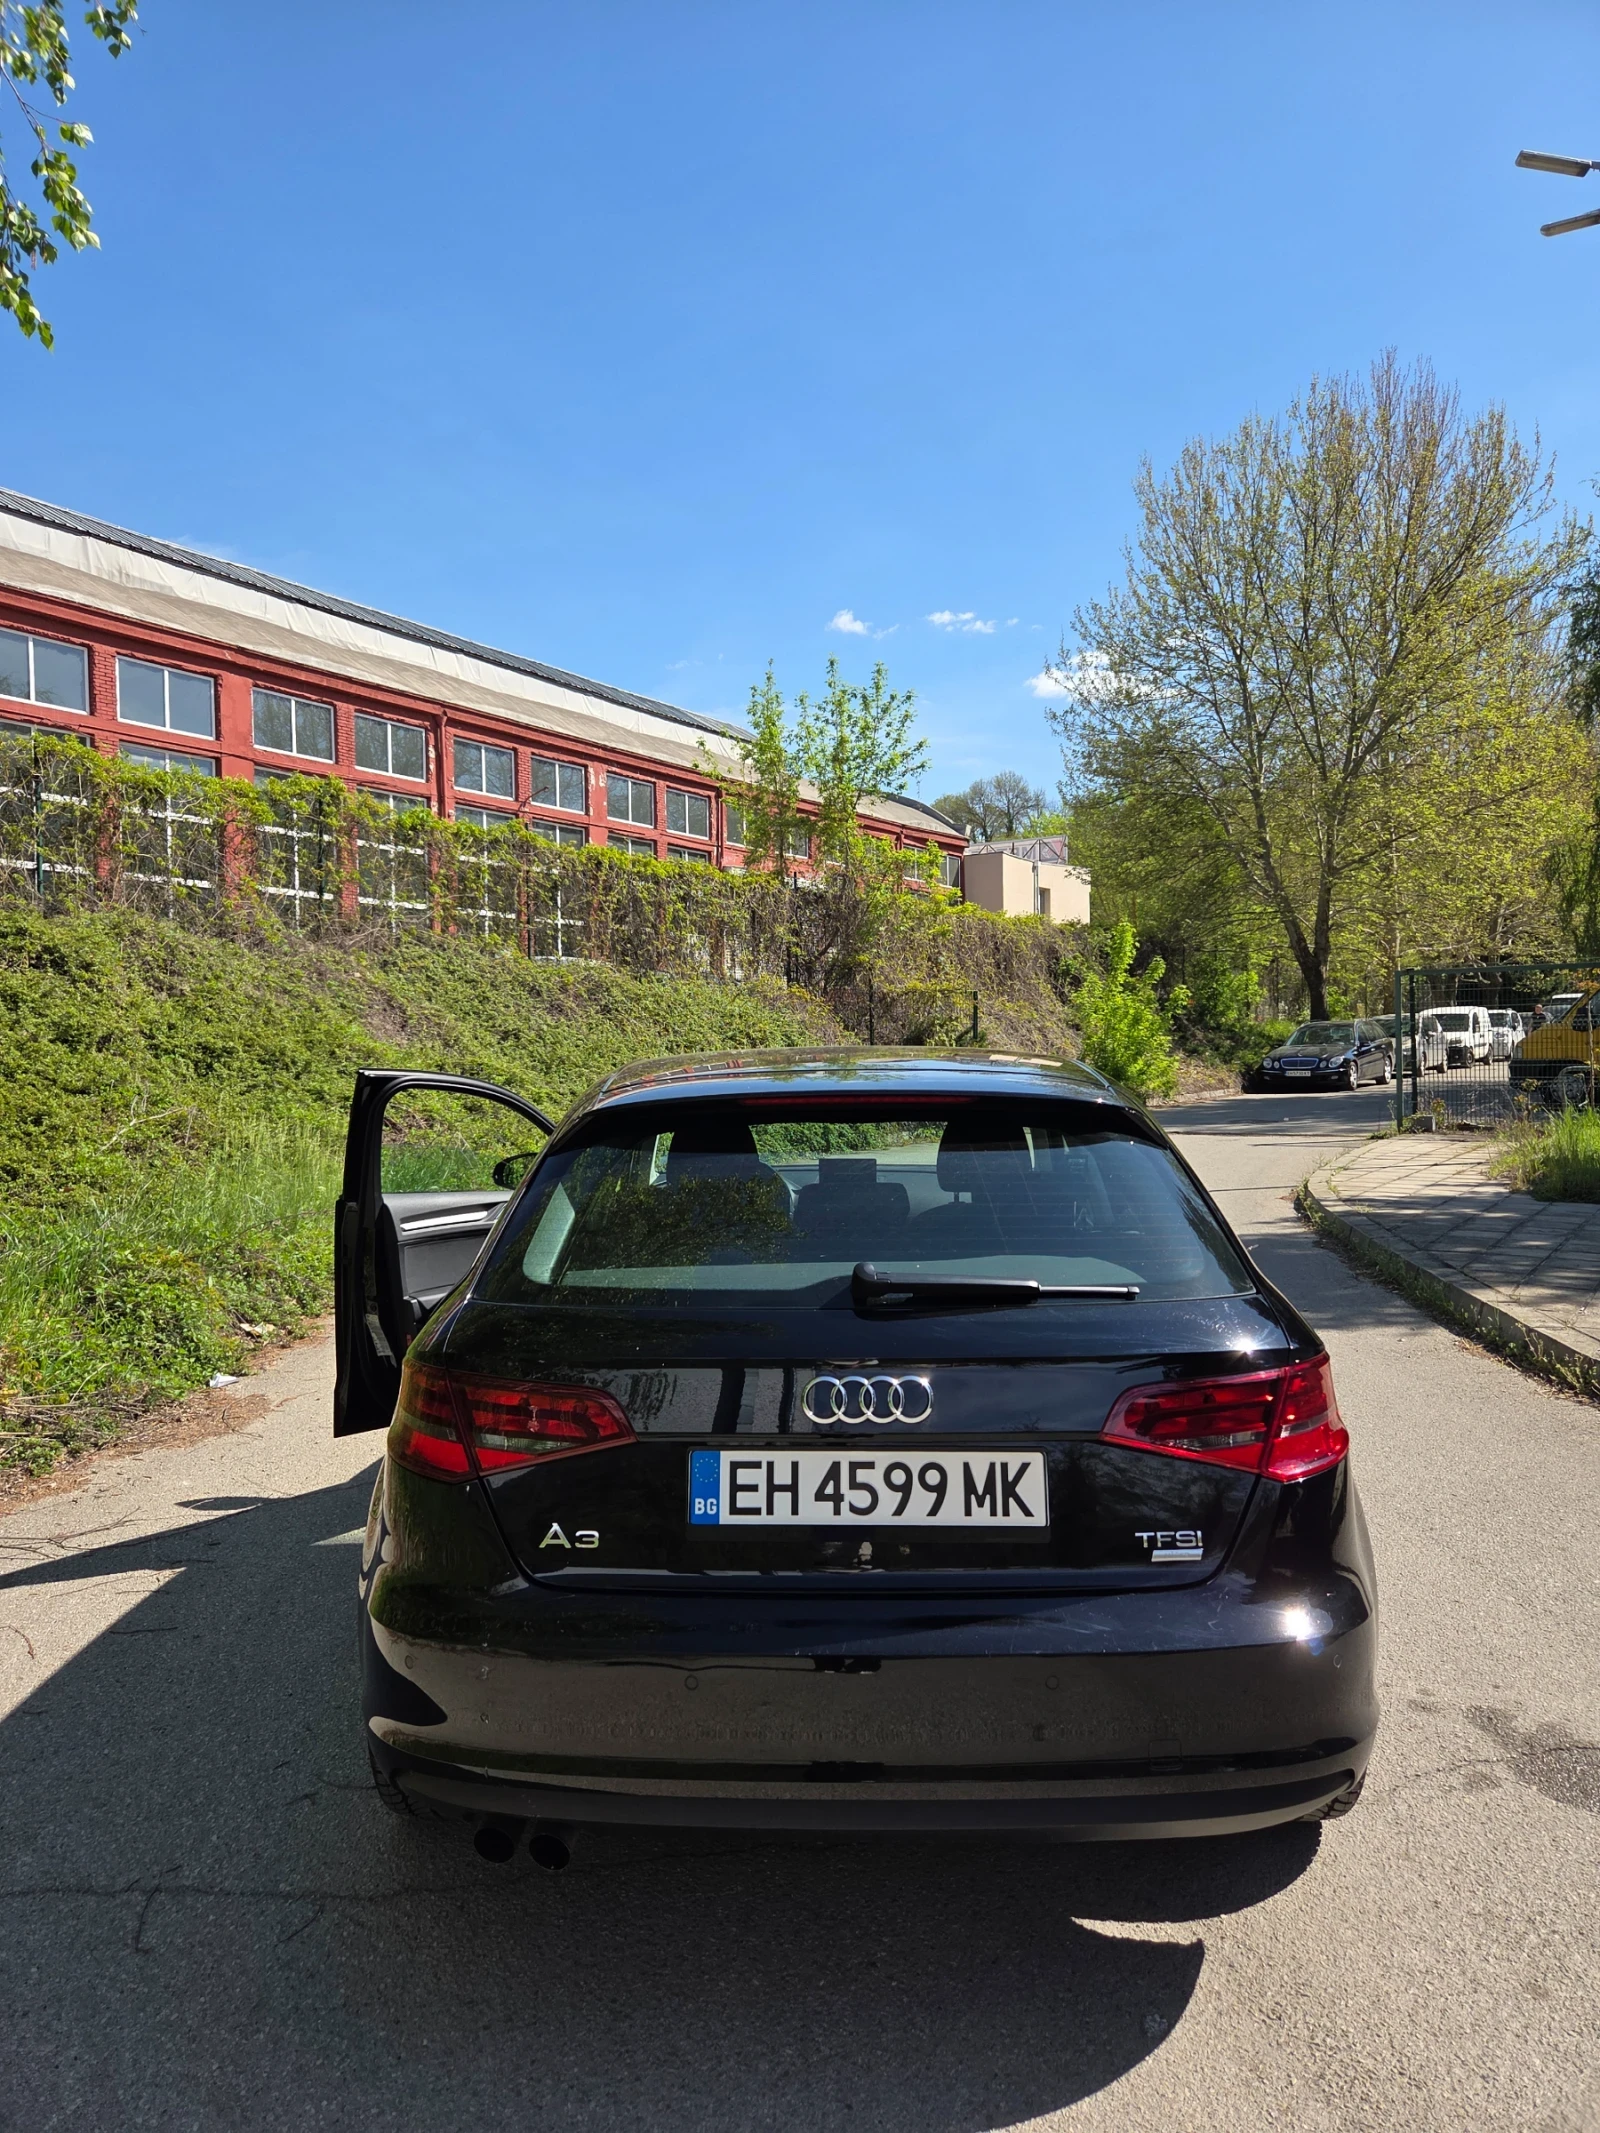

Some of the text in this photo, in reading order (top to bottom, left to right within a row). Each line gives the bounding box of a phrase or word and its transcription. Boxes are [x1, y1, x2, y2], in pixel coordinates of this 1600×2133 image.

[729, 1460, 1036, 1518] EH 4599 MK
[694, 1498, 718, 1515] BG
[538, 1522, 600, 1549] A3
[1134, 1530, 1204, 1549] TFSI
